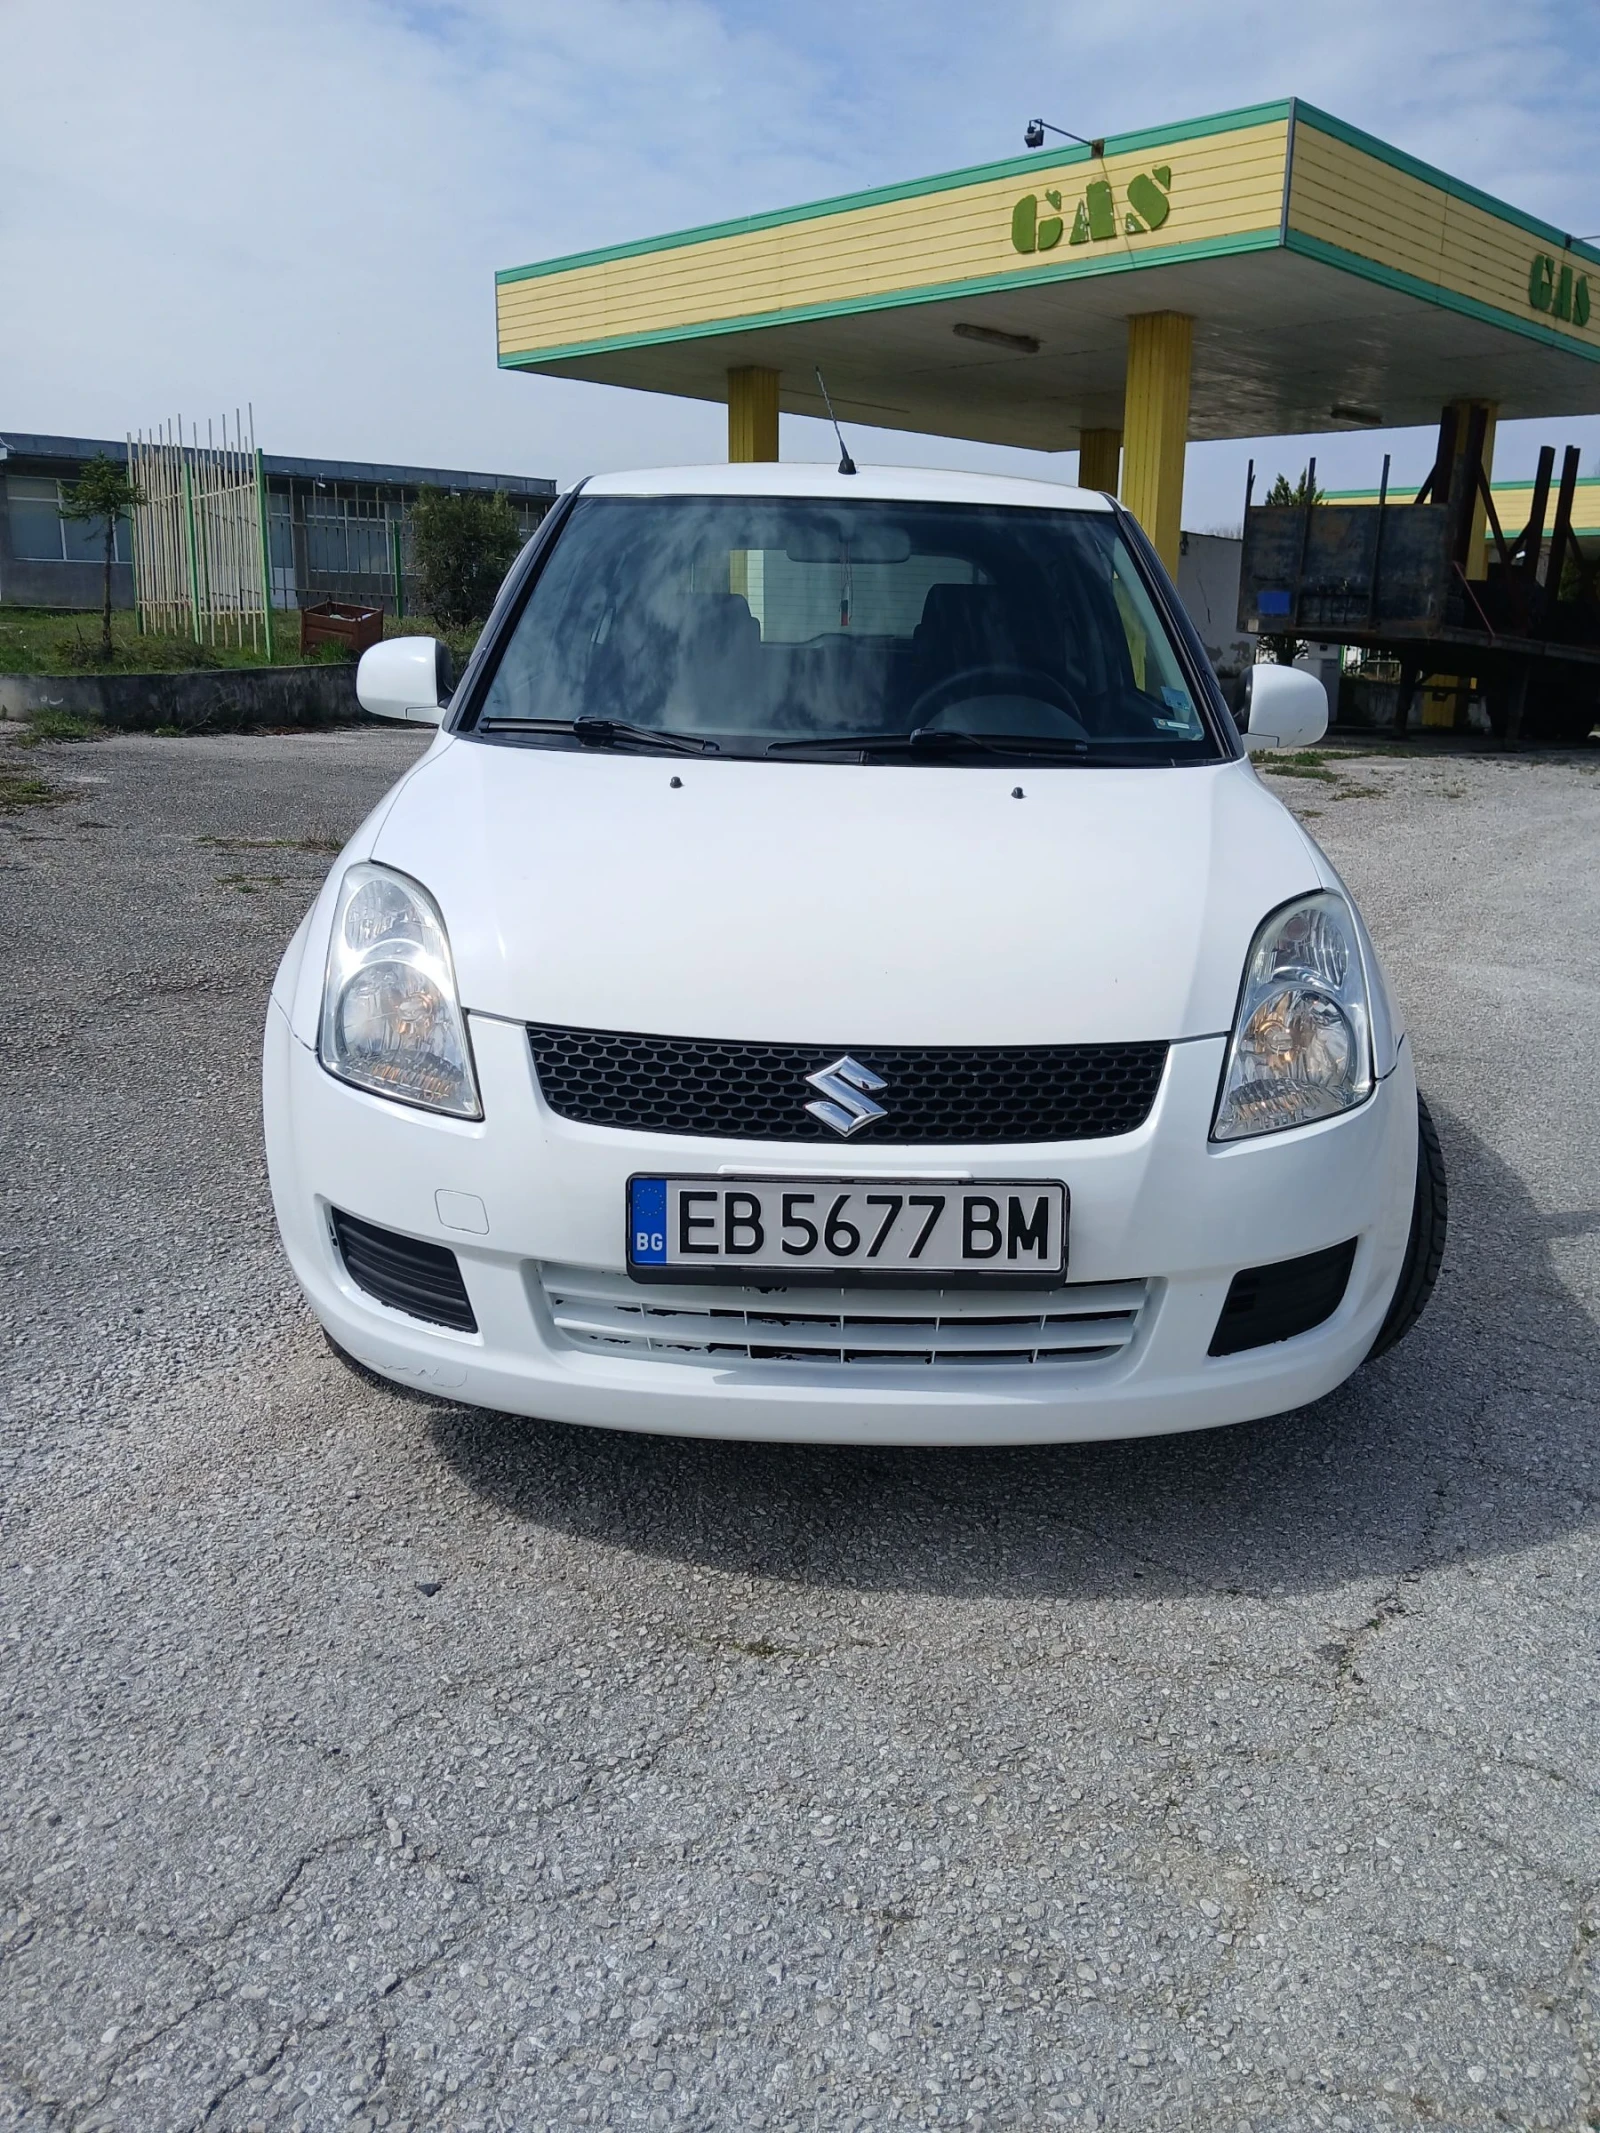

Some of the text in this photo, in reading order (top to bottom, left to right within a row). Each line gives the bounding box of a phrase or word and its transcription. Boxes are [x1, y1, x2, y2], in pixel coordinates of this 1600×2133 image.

[1011, 166, 1171, 253] GAS
[1529, 254, 1590, 327] GAS
[635, 1232, 664, 1252] BG
[679, 1191, 1048, 1260] EB 5677 BM
